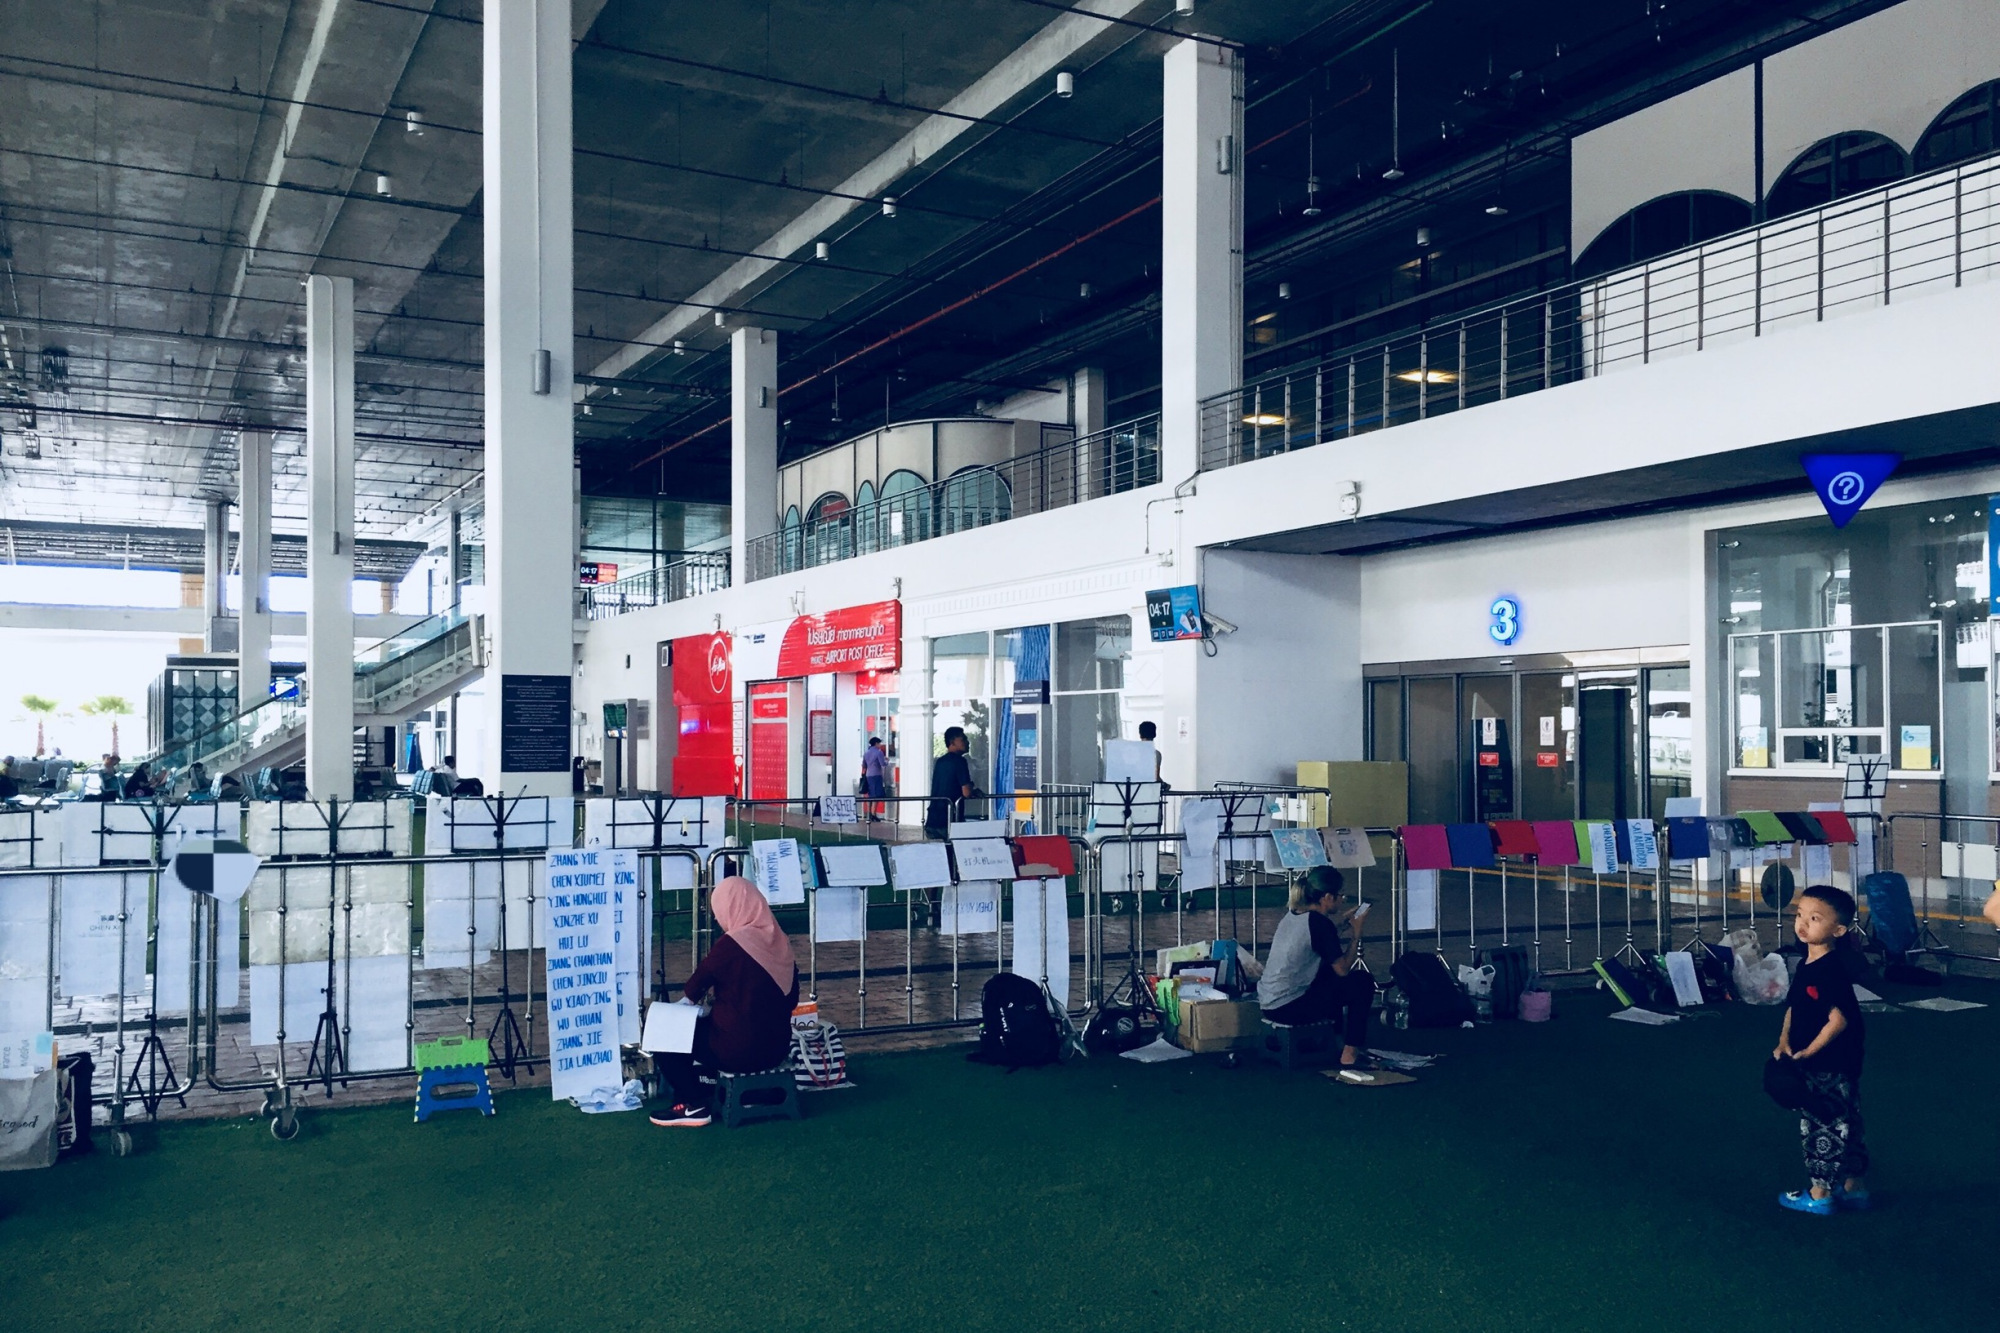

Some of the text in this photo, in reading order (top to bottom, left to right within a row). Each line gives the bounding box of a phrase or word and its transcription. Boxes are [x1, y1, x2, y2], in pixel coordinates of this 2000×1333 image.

[1149, 601, 1170, 617] 04:17
[1490, 599, 1518, 641] 3
[825, 648, 848, 663] AIRPORT
[848, 646, 863, 661] POST
[864, 644, 885, 659] OFFICE
[825, 797, 855, 812] RACHEL
[550, 854, 578, 868] ZHANG
[582, 852, 599, 865] YUE
[551, 872, 605, 888] CHEN XIUMEI
[548, 894, 570, 908] YING
[573, 891, 608, 906] HONGHUI
[553, 913, 585, 928] XINZHE
[588, 912, 599, 924] XU
[558, 935, 589, 950] HUI LU
[548, 952, 612, 971] ZHANG CHANCHAN
[553, 971, 607, 991] CHEN JINXIU
[551, 991, 611, 1011] GU XIAOYING
[557, 1011, 602, 1031] WU CHUAN
[556, 1031, 602, 1052] ZHANG JIE
[558, 1050, 612, 1071] JIA LANZHAO
